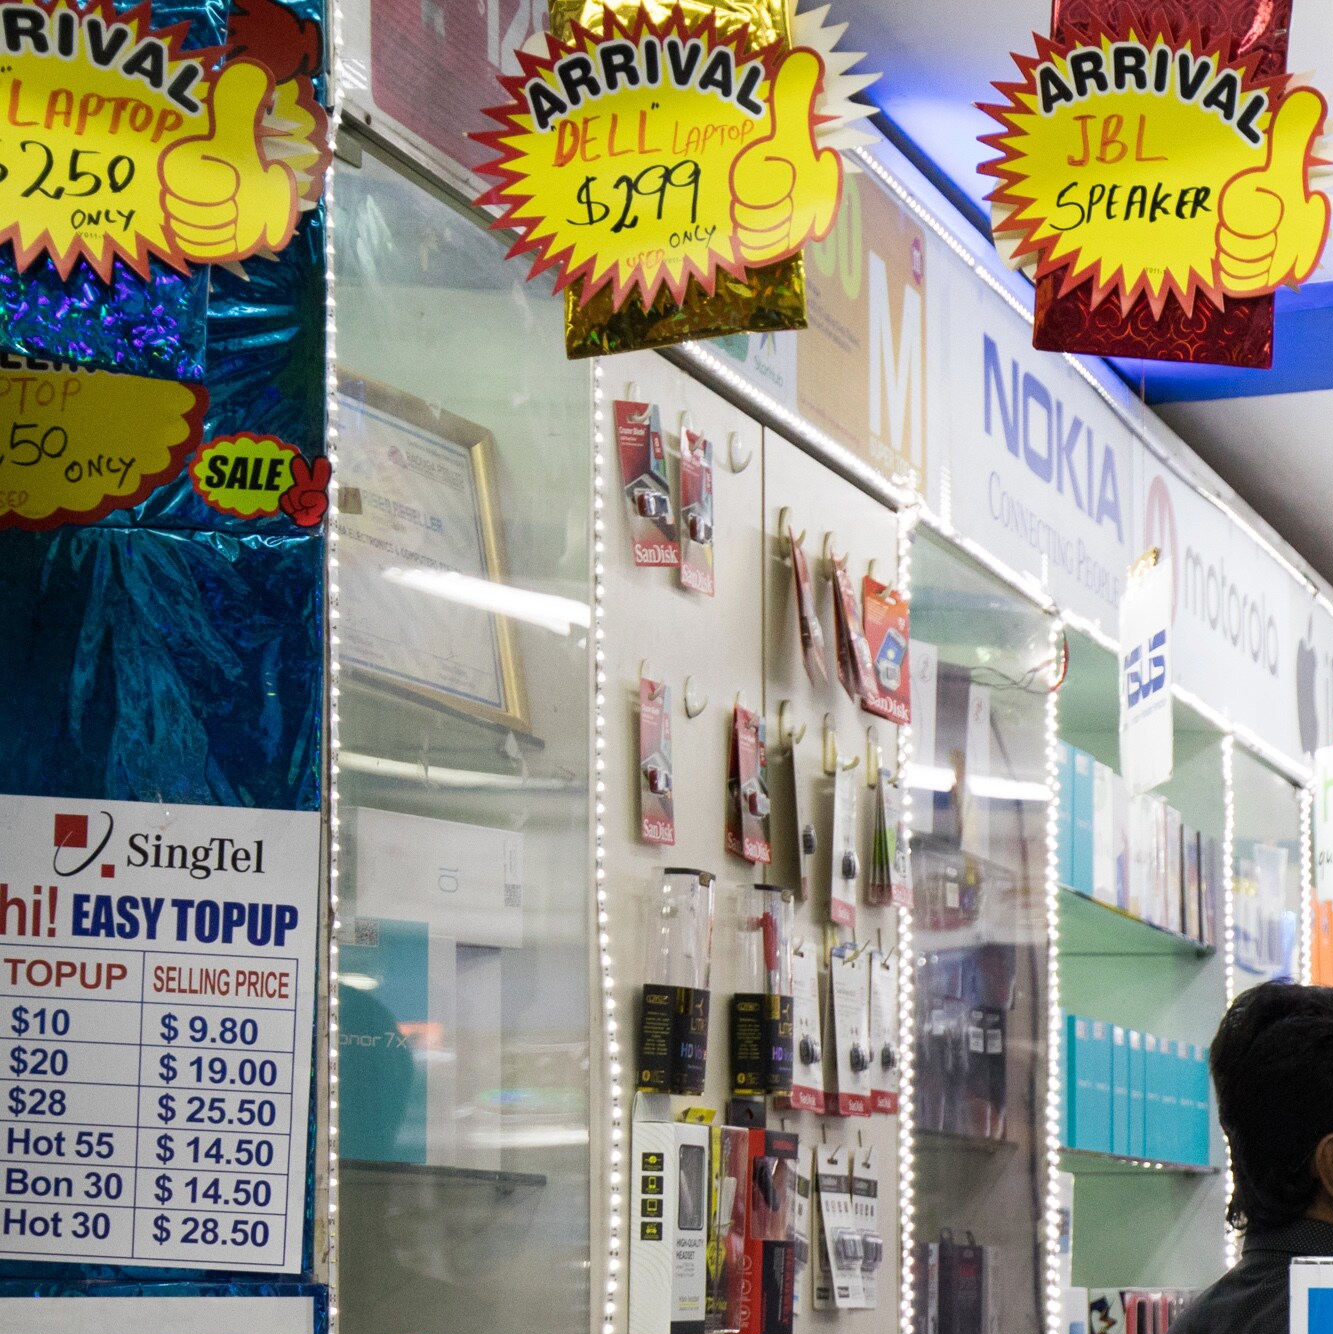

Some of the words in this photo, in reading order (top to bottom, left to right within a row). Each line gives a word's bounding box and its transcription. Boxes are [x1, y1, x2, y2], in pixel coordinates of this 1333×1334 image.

[529, 40, 763, 129] ARRIVAL
[1039, 46, 1268, 144] ARRIVAL
[8, 79, 183, 142] LAPTOP
[672, 120, 754, 156] LAPTOP
[1067, 113, 1169, 166] JBL
[0, 139, 135, 200] 250
[567, 160, 701, 234] $299
[1049, 182, 1212, 231] SPEAKER
[71, 208, 135, 231] ONLY
[669, 226, 716, 249] ONLY
[983, 332, 1124, 545] NOKIA
[65, 455, 135, 489] ONLY
[206, 454, 284, 491] SALE
[635, 542, 679, 565] SanDisk
[1184, 544, 1279, 679] motorola
[867, 698, 909, 721] SanDisk
[643, 819, 673, 840] SanDisk
[126, 833, 266, 880] SingTel
[744, 839, 770, 862] SanDisk
[0, 883, 58, 938] hi!
[72, 893, 165, 940] EASY
[171, 898, 299, 947] TOPUP
[3, 957, 128, 990] TOPUP
[153, 965, 230, 996] SELLING
[236, 969, 290, 999] PRICE
[11, 1005, 71, 1036] $10
[189, 1015, 259, 1044] 9.80
[339, 1033, 383, 1048] onor
[385, 1031, 409, 1049] 7x
[9, 1045, 69, 1077] $20
[189, 1056, 278, 1087] 19.00
[7, 1085, 67, 1117] $28
[186, 1096, 276, 1127] 25.50
[7, 1127, 65, 1157] Hot
[74, 1131, 115, 1159] 55
[185, 1136, 274, 1167] 14.50
[5, 1168, 73, 1198] Bon
[84, 1172, 123, 1200] 30
[184, 1176, 272, 1207] 14.50
[3, 1208, 63, 1238] Hot
[71, 1212, 110, 1240] 30
[180, 1217, 270, 1248] 28.50
